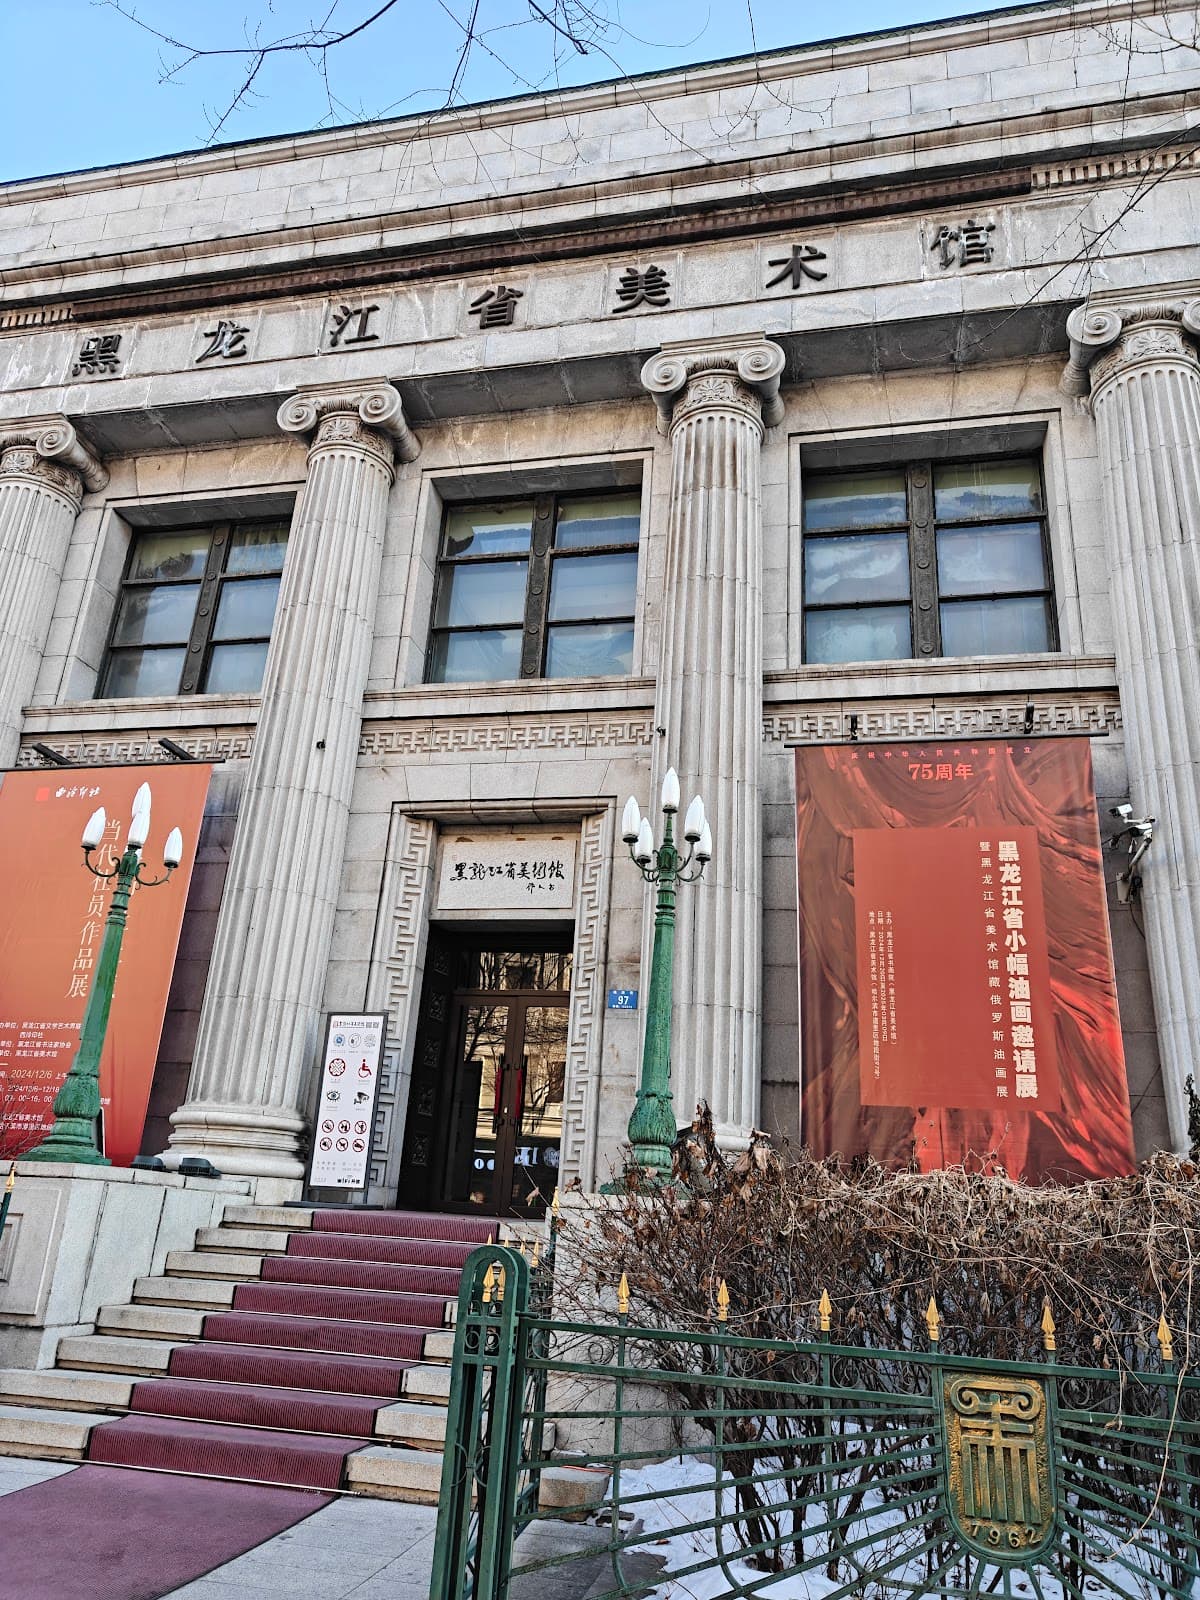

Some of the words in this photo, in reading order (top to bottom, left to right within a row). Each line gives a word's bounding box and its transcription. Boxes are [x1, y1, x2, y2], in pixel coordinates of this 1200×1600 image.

[72, 220, 997, 376] 黑龙江省美术馆
[851, 746, 1032, 760] 庆祝中华人民共和国成立
[908, 763, 974, 781] 75周年
[979, 841, 1009, 1098] 暨黑龙江省美术馆藏俄罗斯油画展
[997, 840, 1039, 1099] 黑龙江省小幅油画邀请展
[617, 995, 629, 1005] 97
[971, 1523, 1041, 1549] 1962
